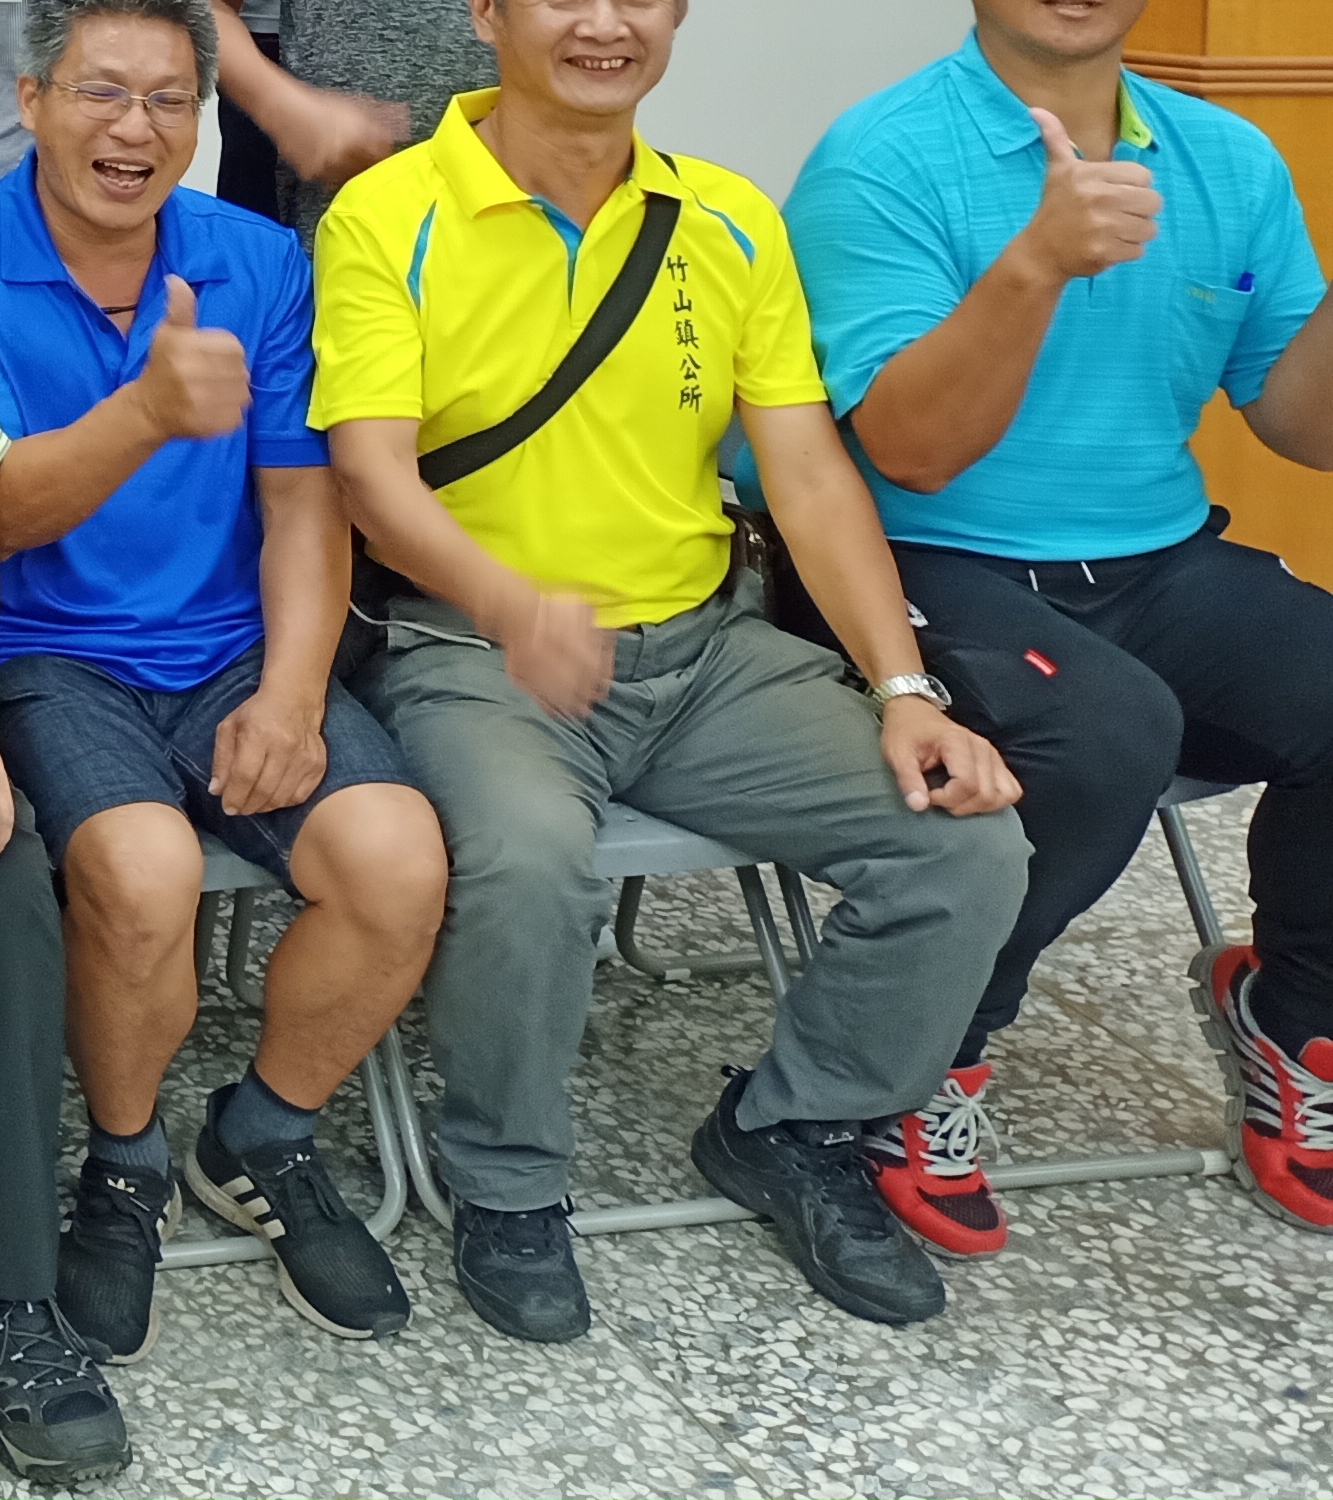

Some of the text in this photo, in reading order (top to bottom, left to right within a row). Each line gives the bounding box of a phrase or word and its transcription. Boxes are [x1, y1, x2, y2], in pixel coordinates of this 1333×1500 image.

[666, 254, 703, 414] 竹山鎮公所
